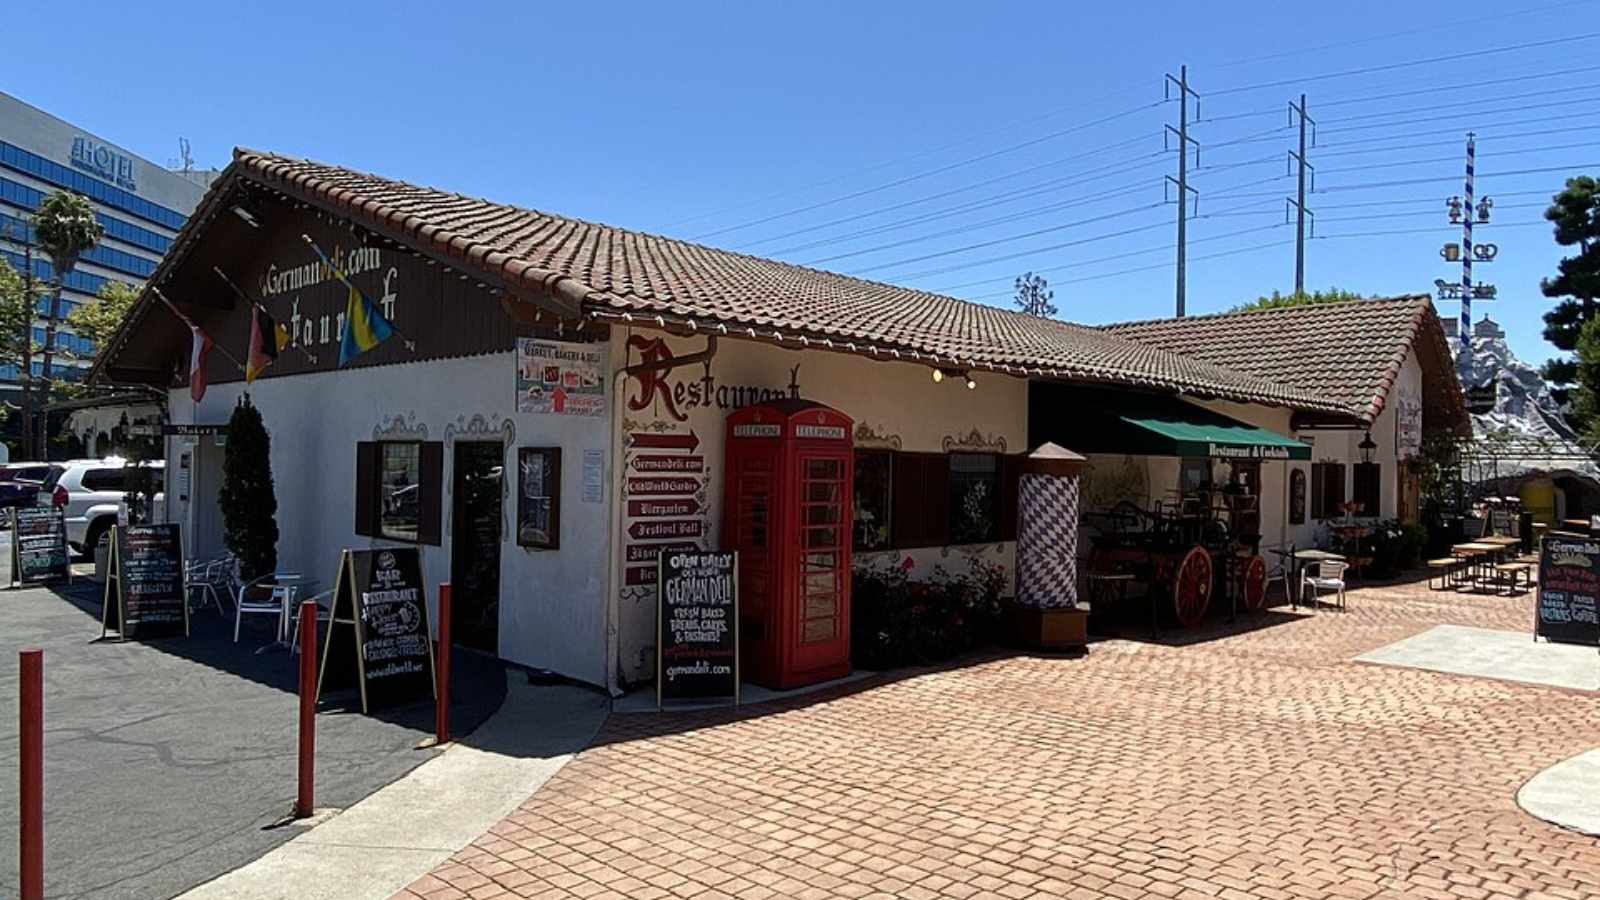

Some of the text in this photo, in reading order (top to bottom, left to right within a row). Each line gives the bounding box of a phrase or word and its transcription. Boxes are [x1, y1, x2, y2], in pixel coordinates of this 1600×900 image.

[628, 334, 801, 422] Restaurant
[1209, 443, 1289, 458] Restaurant & Cocktails
[669, 553, 732, 569] OPEN DAILY
[362, 588, 418, 606] RESTAURANT
[666, 576, 708, 605] GERMAN
